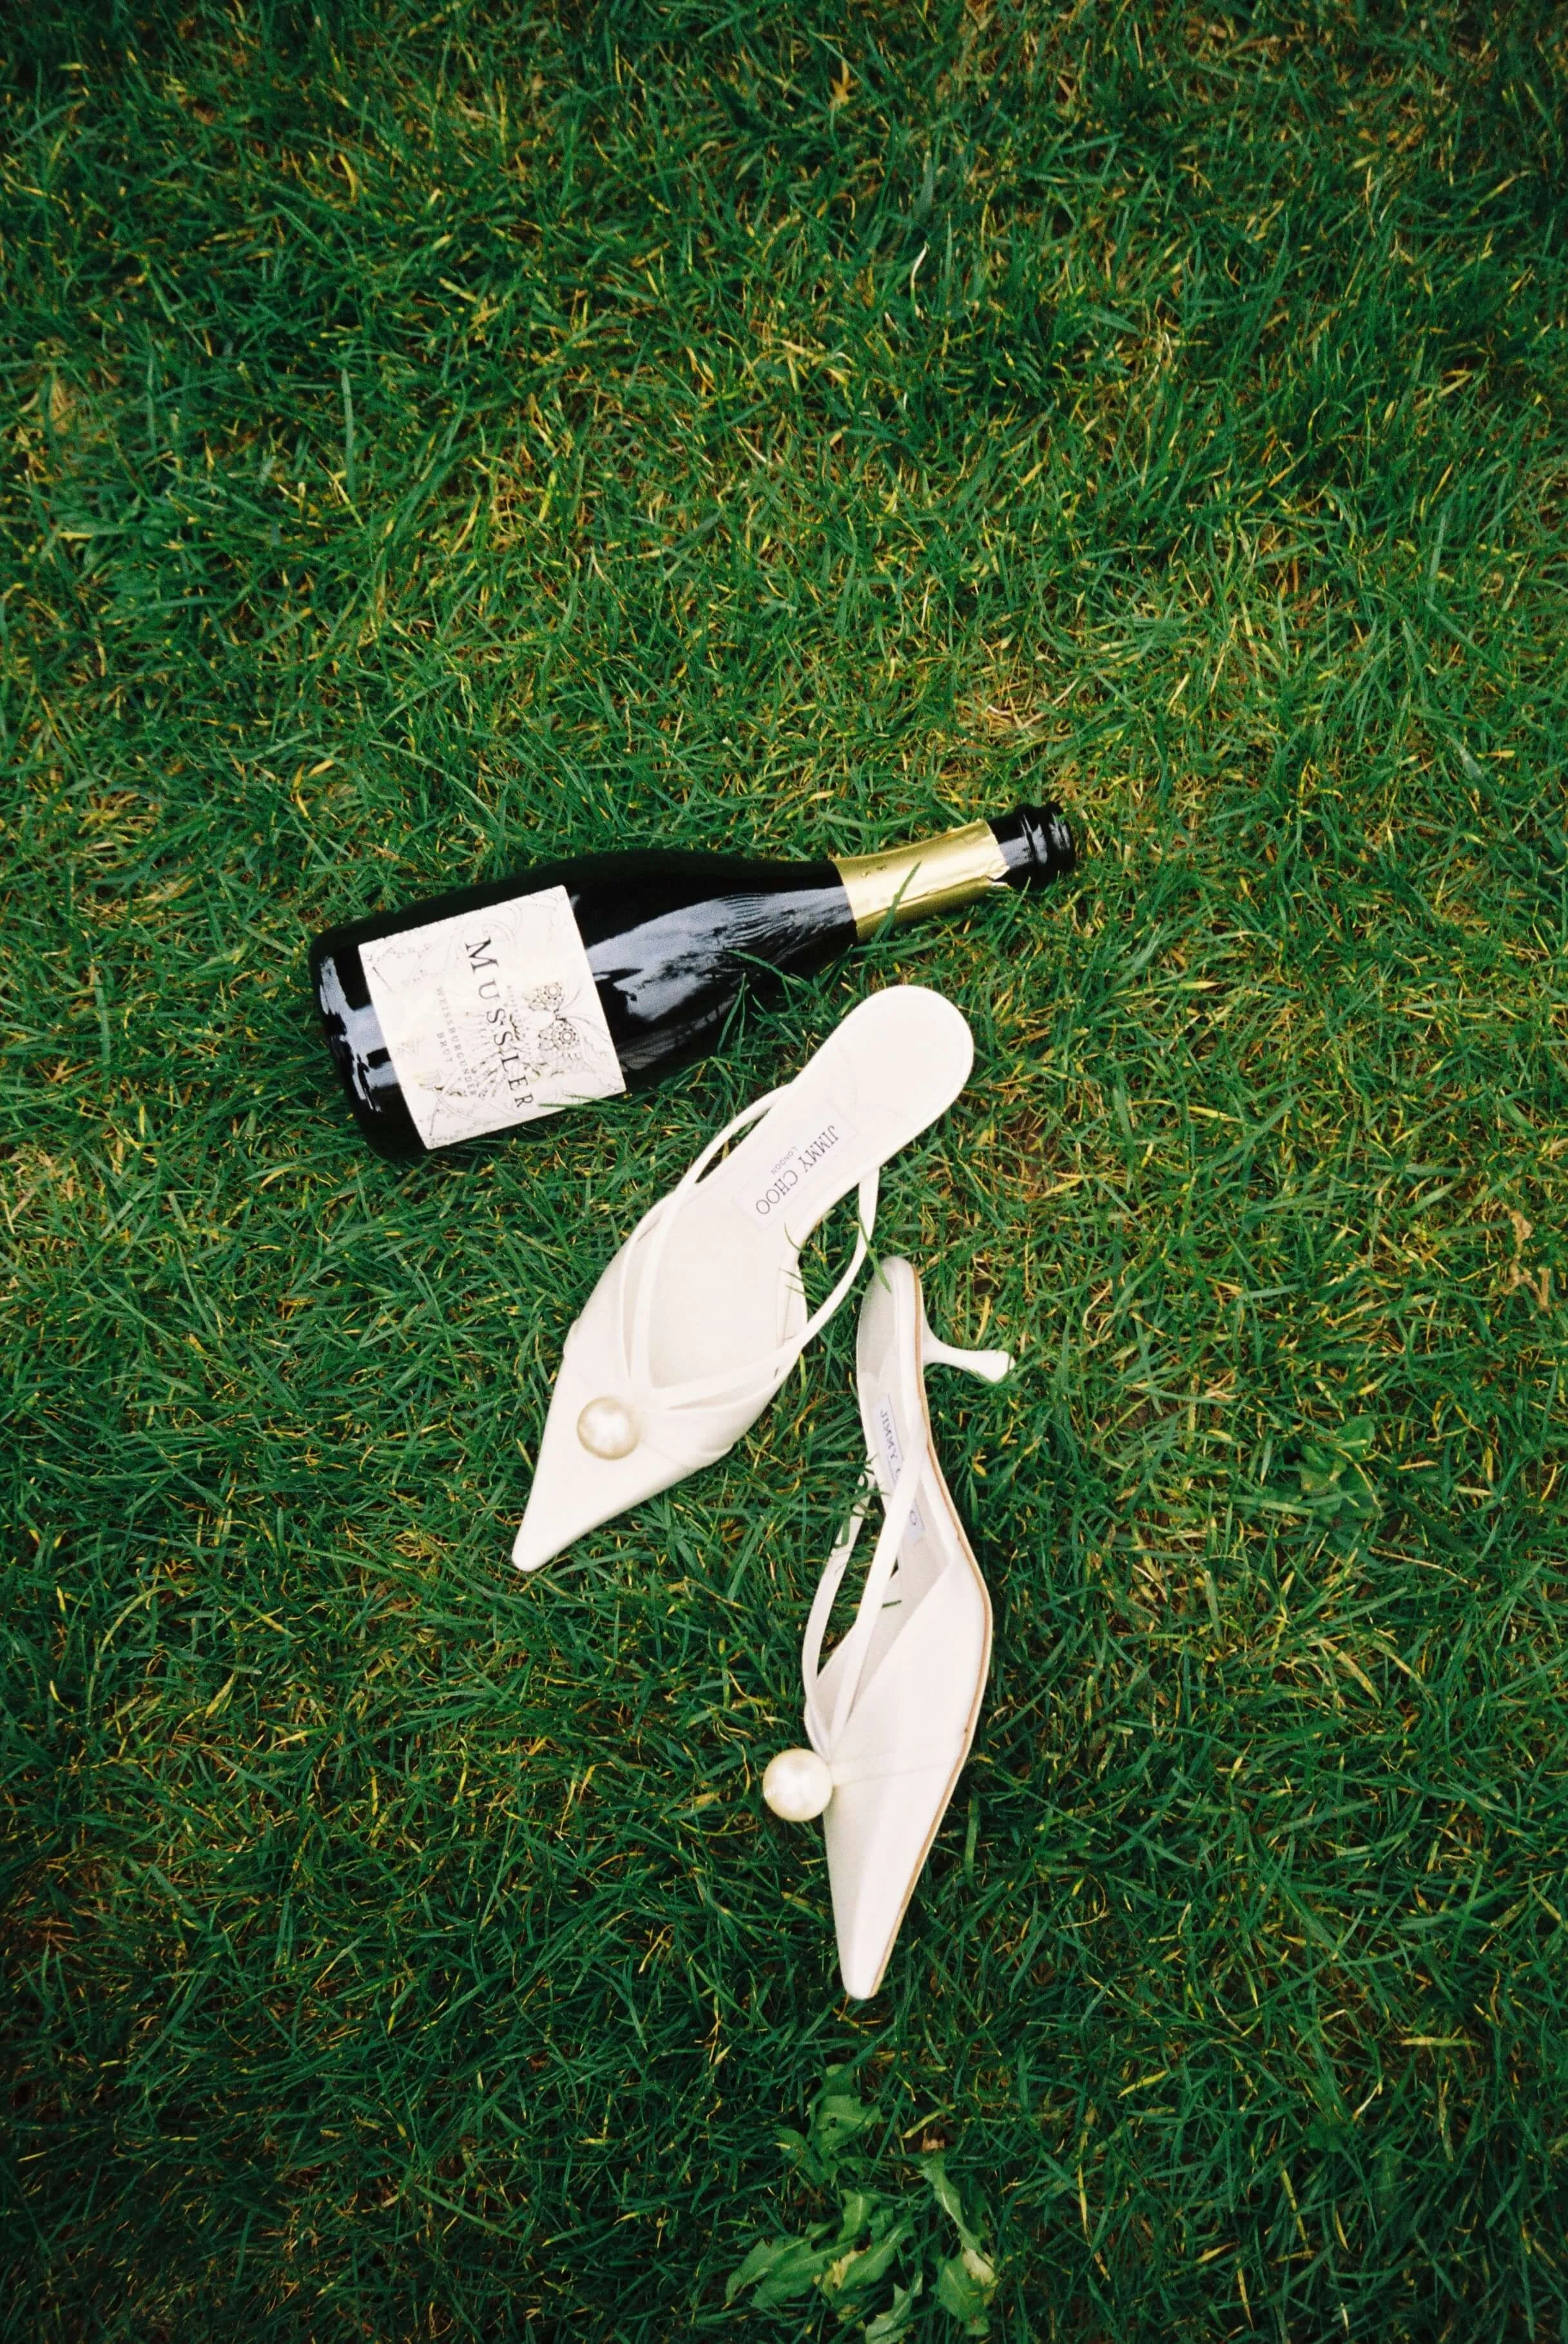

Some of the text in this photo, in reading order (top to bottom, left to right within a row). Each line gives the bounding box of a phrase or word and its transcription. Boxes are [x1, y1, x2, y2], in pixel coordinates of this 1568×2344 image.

[436, 987, 476, 1096] WEISSBURGUNDER
[437, 1032, 453, 1063] BRUT
[465, 936, 534, 1107] MUSSLER
[755, 1125, 839, 1214] JIMMY CHOO
[771, 1146, 799, 1175] LONDON
[880, 1408, 897, 1459] JIMMY
